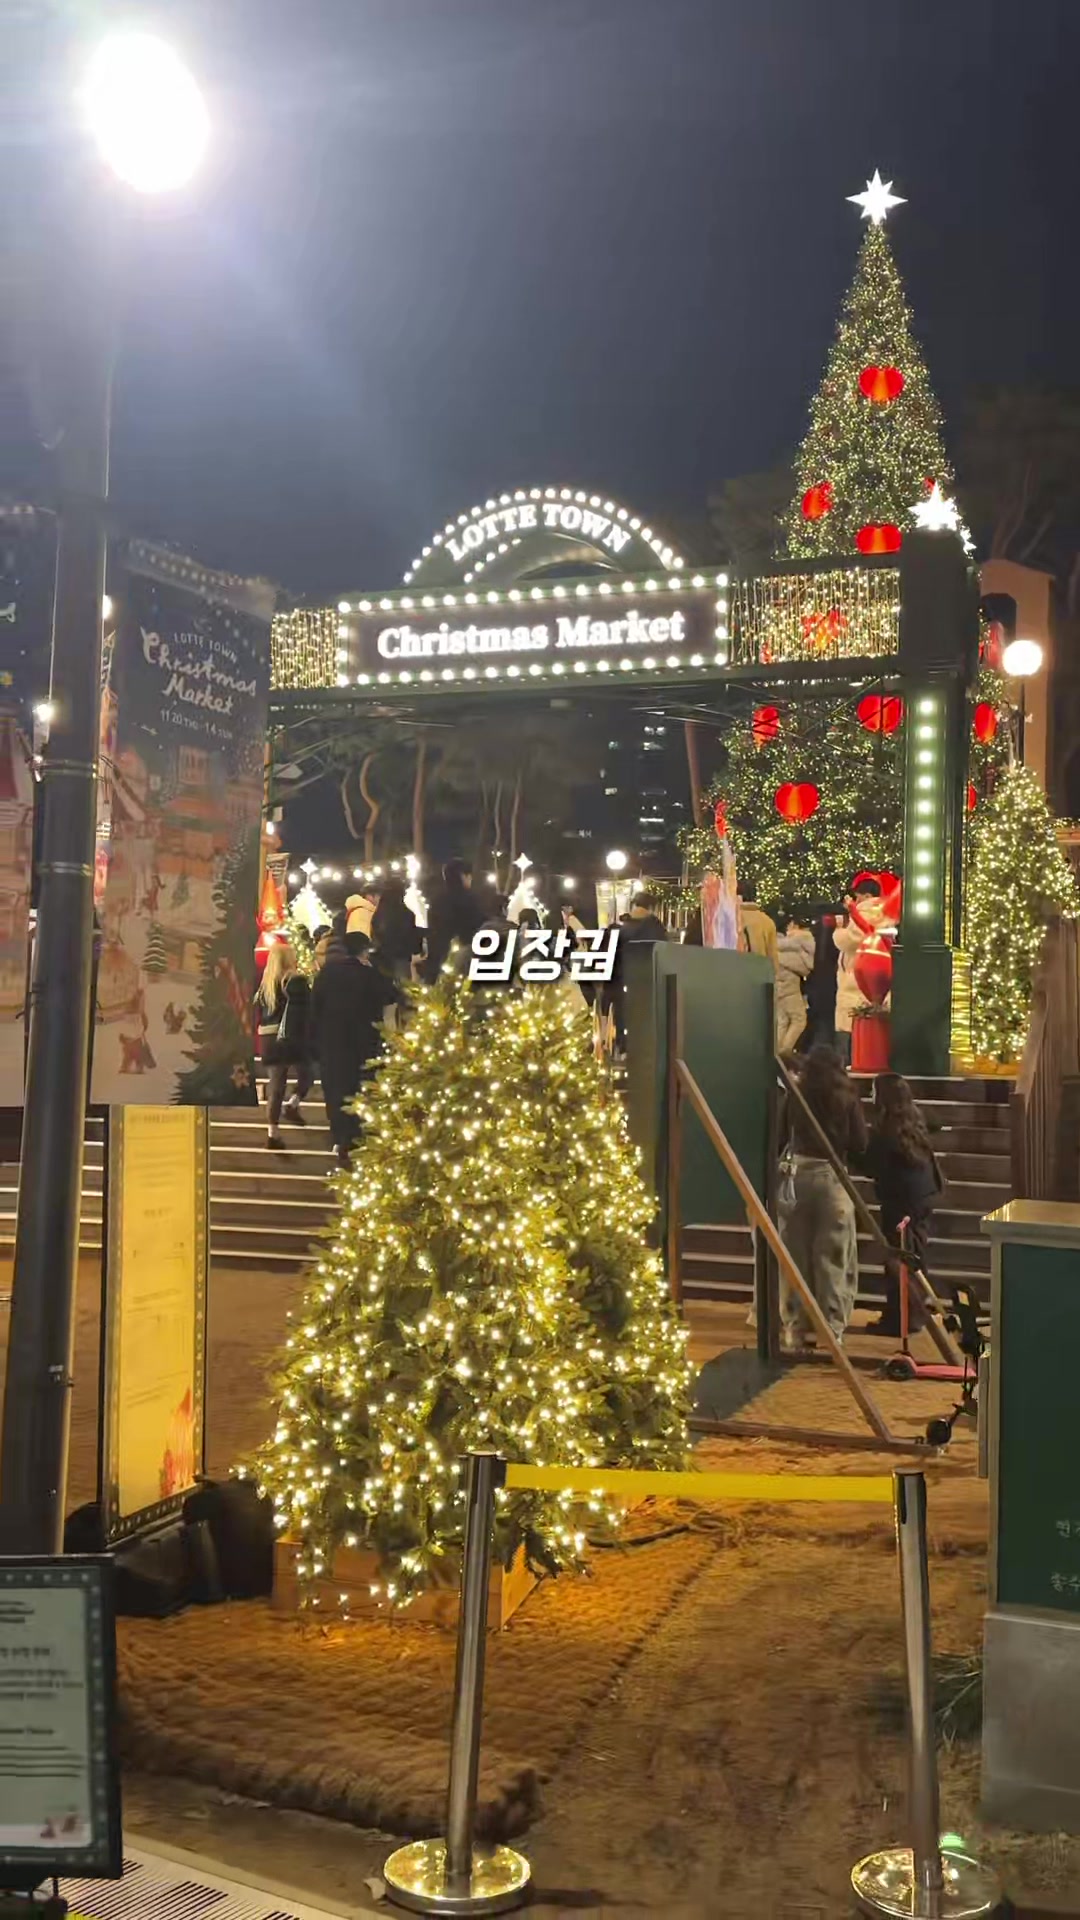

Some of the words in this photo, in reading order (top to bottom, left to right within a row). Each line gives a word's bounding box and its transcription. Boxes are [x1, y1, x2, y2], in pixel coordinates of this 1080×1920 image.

[444, 503, 538, 562] LOTTE
[542, 502, 632, 554] TOWN
[173, 631, 204, 649] LOTTE
[209, 640, 238, 664] TOWN
[377, 622, 549, 660] Christmas
[555, 609, 687, 649] Market
[139, 625, 257, 697] Christmas
[161, 672, 234, 716] Market
